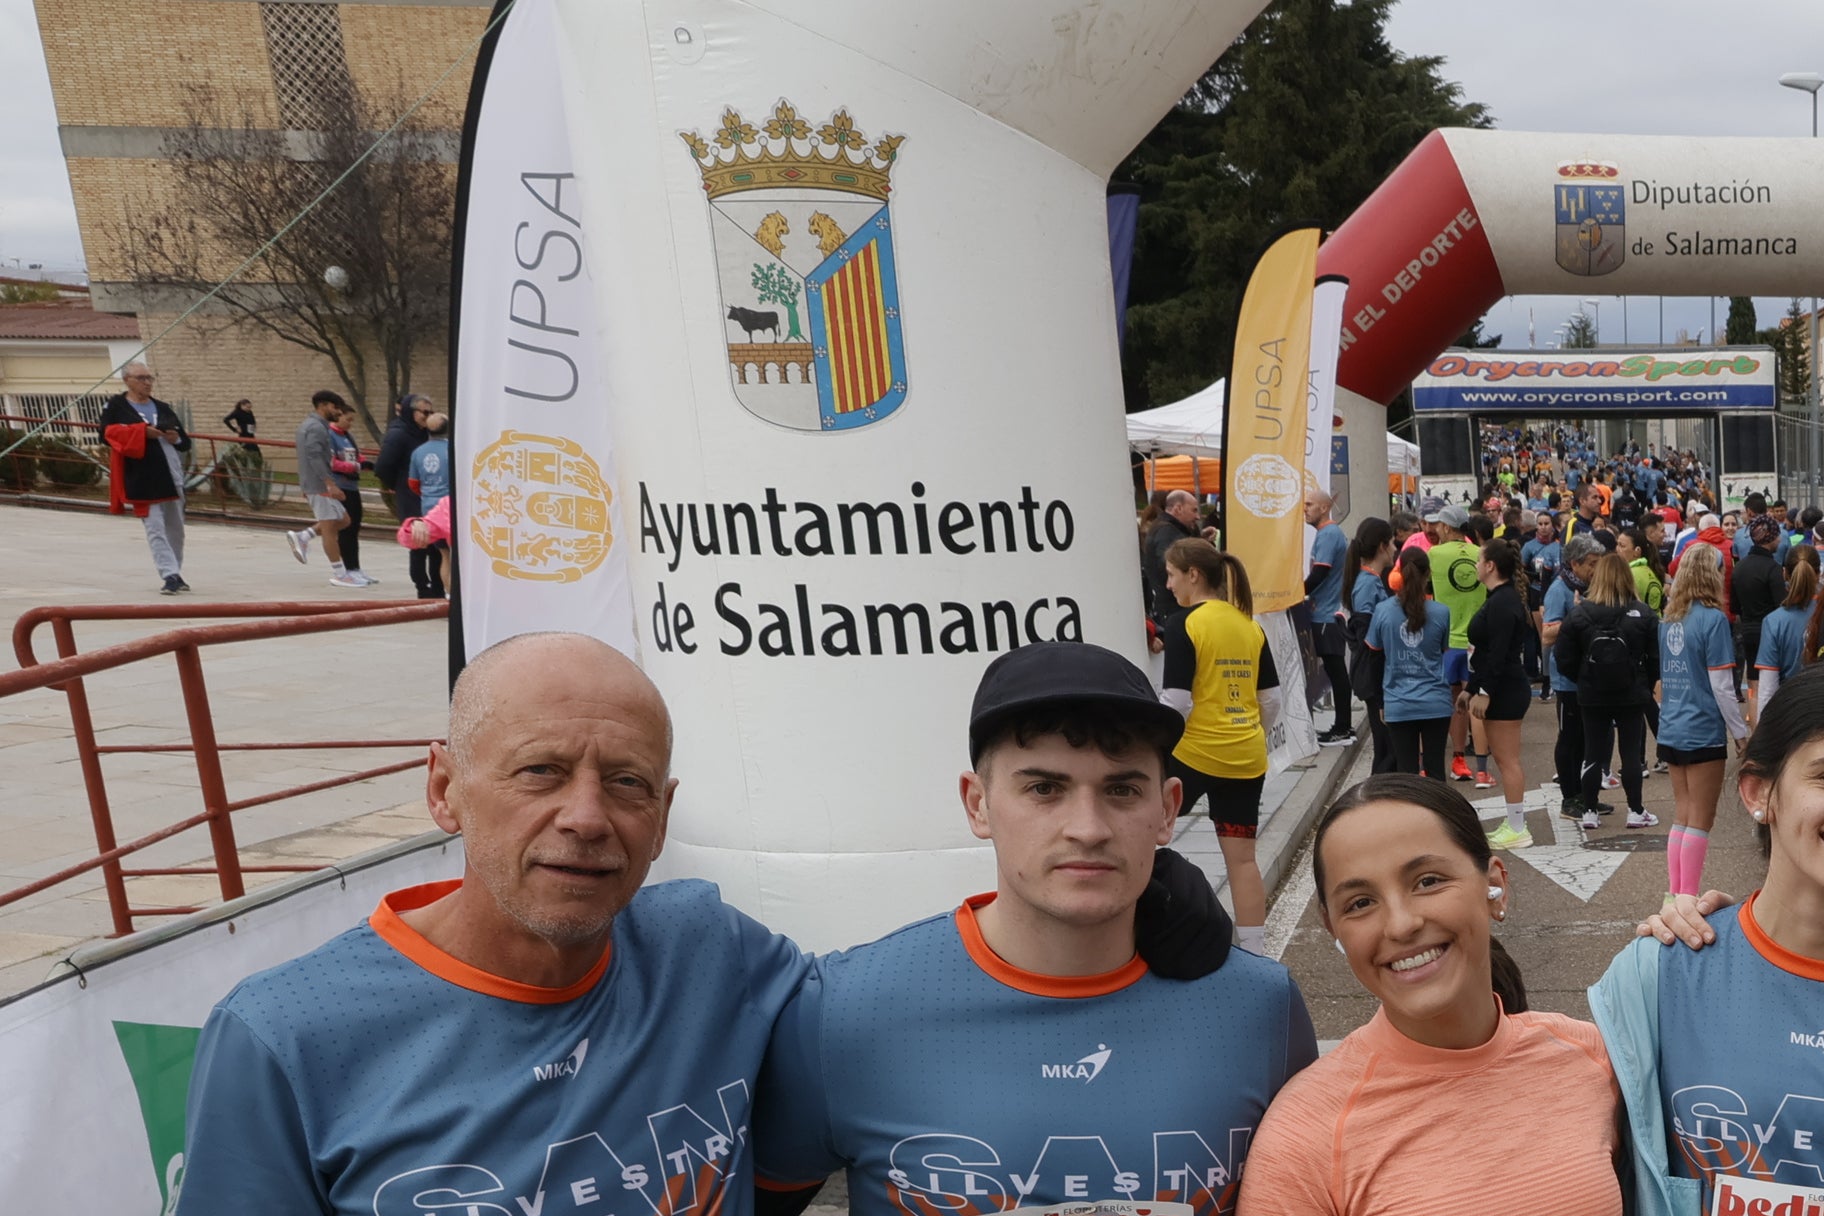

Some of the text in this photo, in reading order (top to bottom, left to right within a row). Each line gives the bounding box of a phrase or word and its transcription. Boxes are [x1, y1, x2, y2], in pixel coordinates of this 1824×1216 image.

[1632, 179, 1771, 210] Diputación
[1632, 231, 1797, 255] de Salamanca
[1353, 304, 1387, 332] EL
[1381, 208, 1478, 304] DEPORTE
[505, 171, 584, 402] UPSA
[1254, 338, 1287, 440] UPSA
[1461, 388, 1728, 404] www.orycronsport.com
[638, 481, 1075, 572] Ayuntamiento
[653, 581, 1084, 656] de Salamanca
[1398, 649, 1426, 661] UPSA
[1663, 660, 1688, 673] UPSA
[533, 1059, 574, 1082] MKA
[1042, 1064, 1089, 1079] MKA
